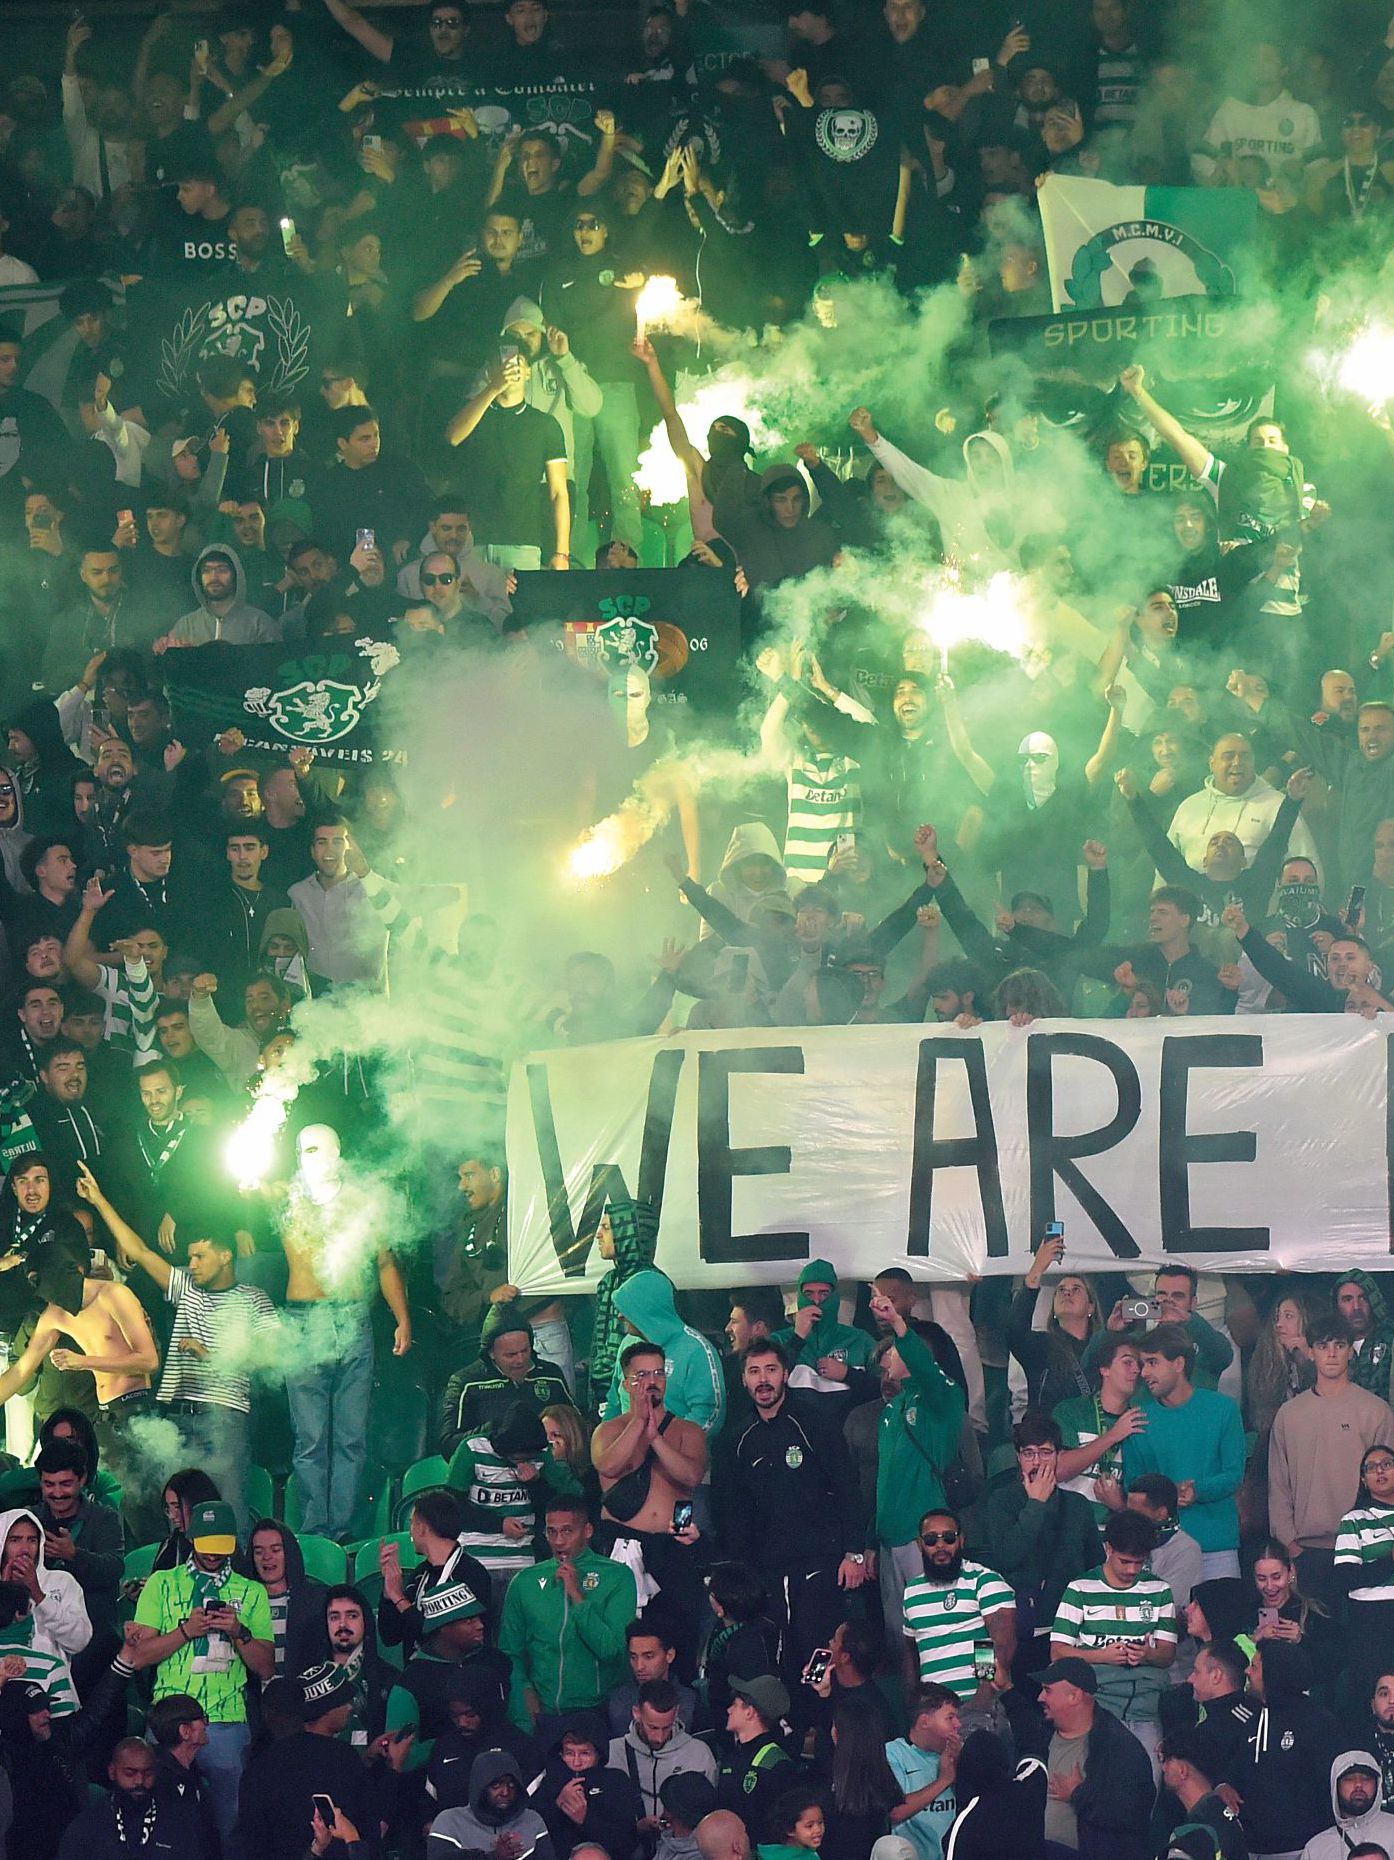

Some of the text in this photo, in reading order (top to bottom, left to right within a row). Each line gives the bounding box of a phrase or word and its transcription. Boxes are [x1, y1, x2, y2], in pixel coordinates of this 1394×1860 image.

[209, 295, 268, 329] SCP
[1043, 313, 1227, 348] SPORTING
[599, 598, 652, 621] SCP
[690, 638, 708, 652] 06
[381, 749, 408, 767] 24
[526, 1046, 810, 1278] WE
[907, 1032, 1271, 1258] ARE
[304, 1678, 335, 1701] JUVE
[925, 1798, 956, 1813] tan
